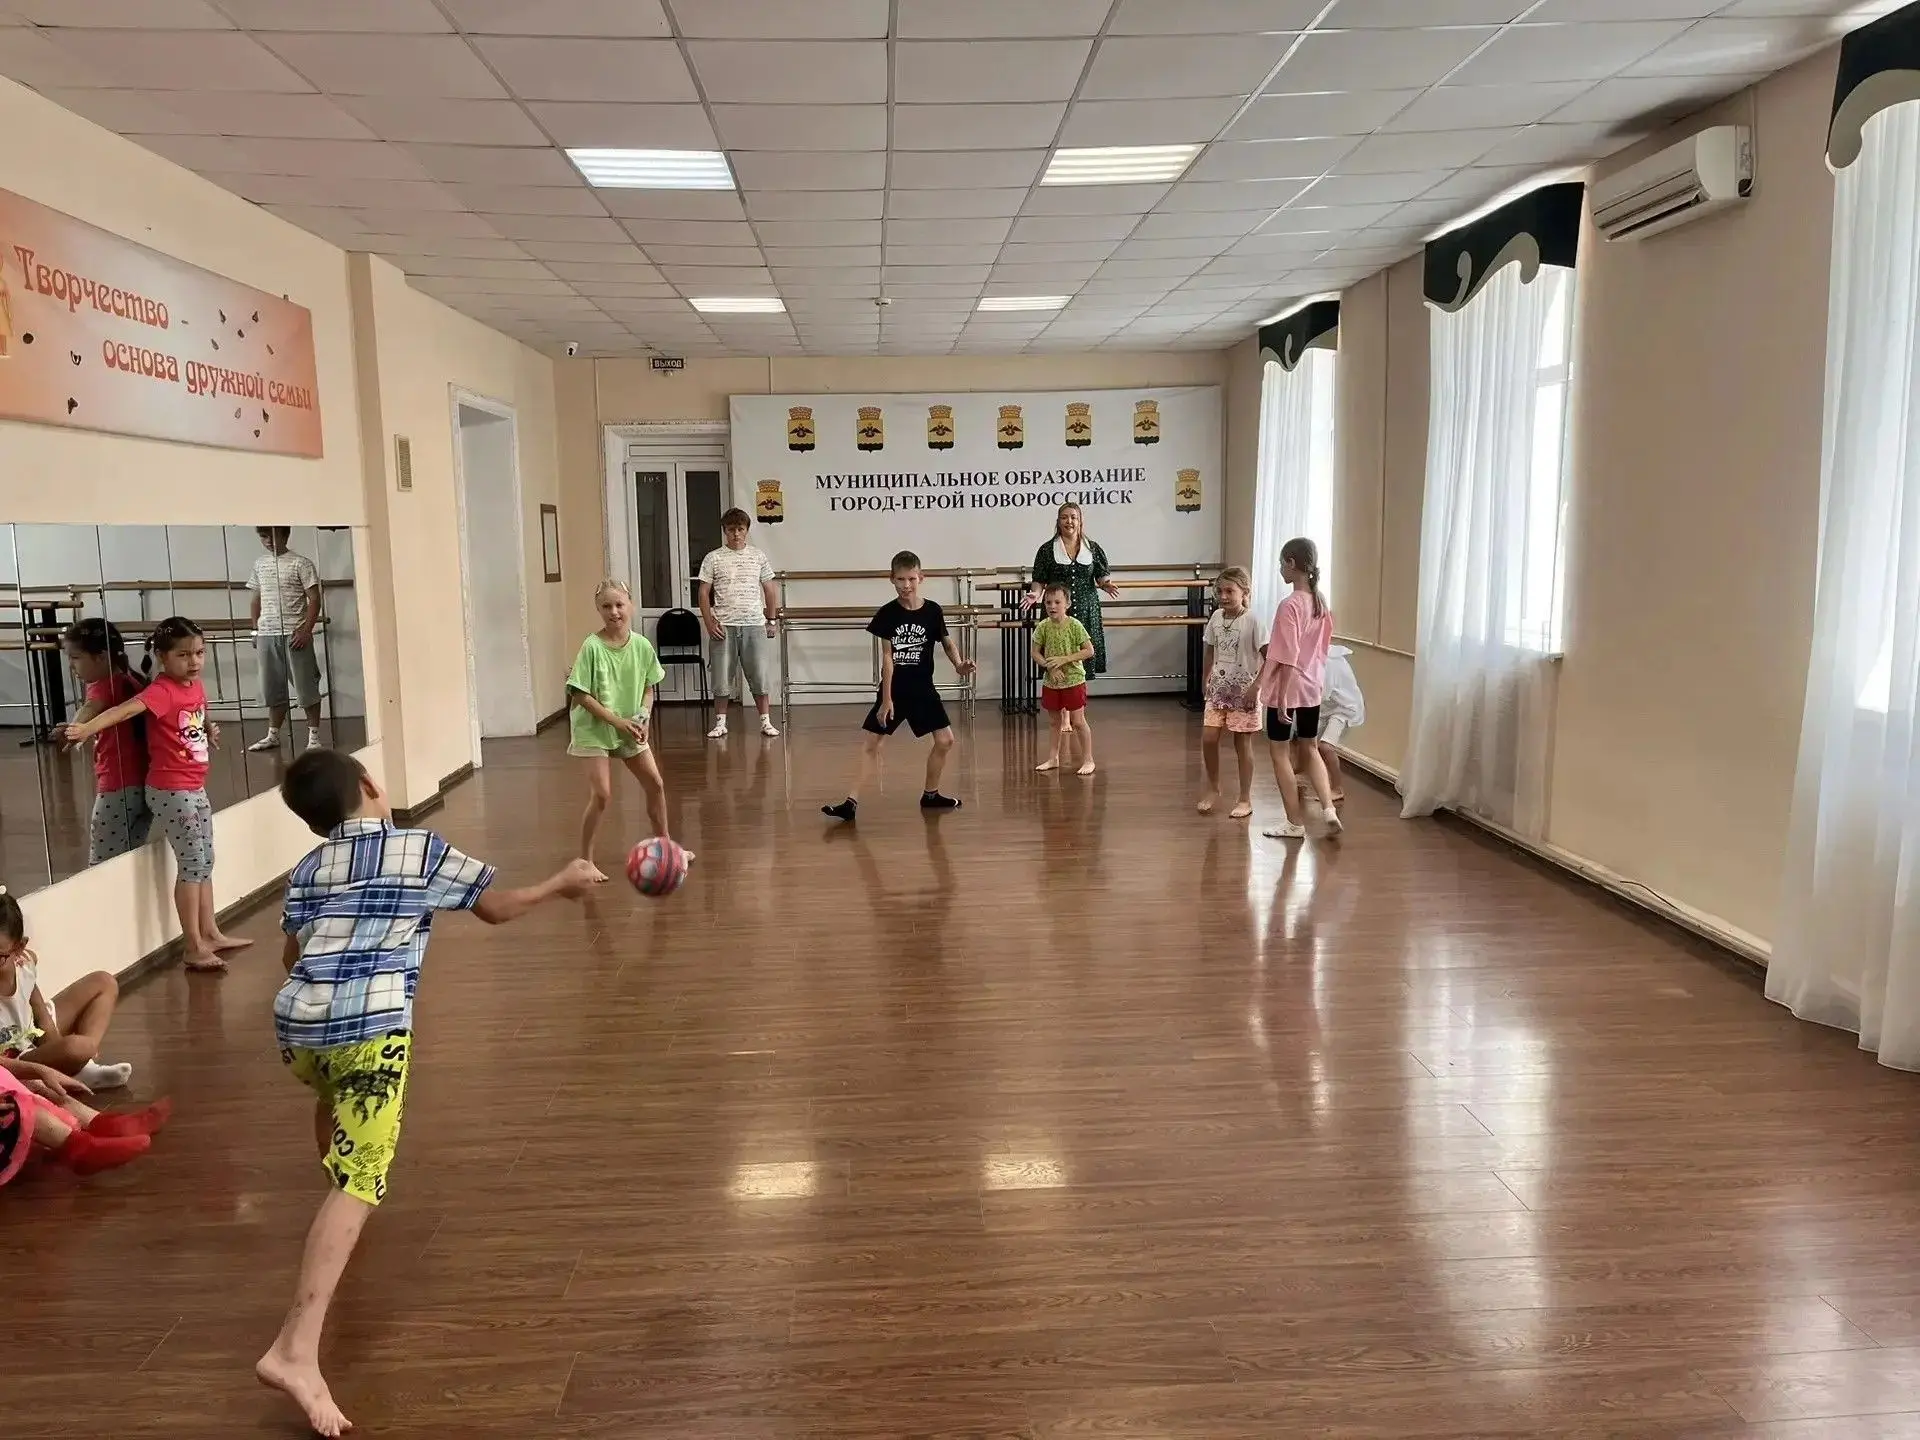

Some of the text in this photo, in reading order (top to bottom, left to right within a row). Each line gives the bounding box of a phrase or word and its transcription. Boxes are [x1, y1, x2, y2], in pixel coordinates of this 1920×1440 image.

[13, 245, 169, 329] Творчество
[654, 359, 682, 368] ВЫХОД
[103, 340, 312, 411] основа дружной семьи
[815, 468, 1146, 490] МУНИЦИПАЛЬНОЕ ОБРАЗОВАНИЕ
[830, 487, 1132, 512] ГОРОД-ГЕРОЙ НОВОРОССИЙСК
[896, 623, 925, 635] HOT ROD
